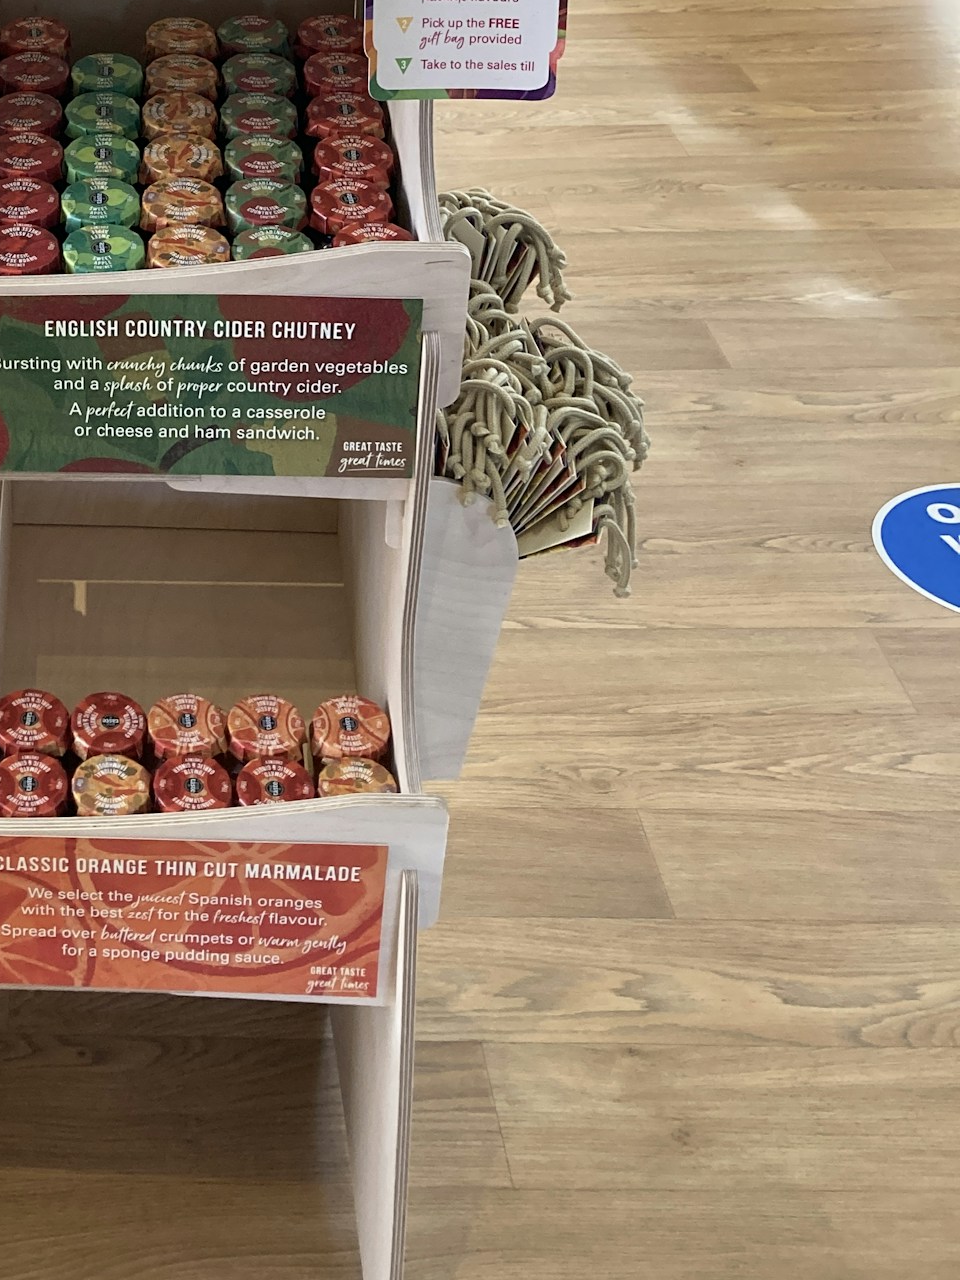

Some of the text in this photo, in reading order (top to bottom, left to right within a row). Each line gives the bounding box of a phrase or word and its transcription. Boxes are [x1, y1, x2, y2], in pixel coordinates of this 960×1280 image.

[422, 18, 519, 31] Pick up the FREE
[419, 30, 522, 49] gift bag provided
[401, 61, 406, 69] 3
[421, 60, 534, 71] Take to the sales till
[44, 320, 356, 340] ENGLISH COUNTRY CIDER CHUTNEY
[66, 357, 103, 370] with
[107, 358, 165, 377] crunchy
[170, 357, 224, 373] chunks
[228, 358, 246, 371] of
[250, 359, 310, 374] garden
[315, 360, 408, 376] vegetables
[76, 858, 147, 875] ORANGE
[155, 860, 197, 876] THIN
[204, 862, 238, 877] CUT
[245, 864, 361, 882] MARMALADE
[28, 887, 322, 910] We select the juiciest Spanish oranges
[21, 905, 327, 926] with the best zest for the freshest flavour.
